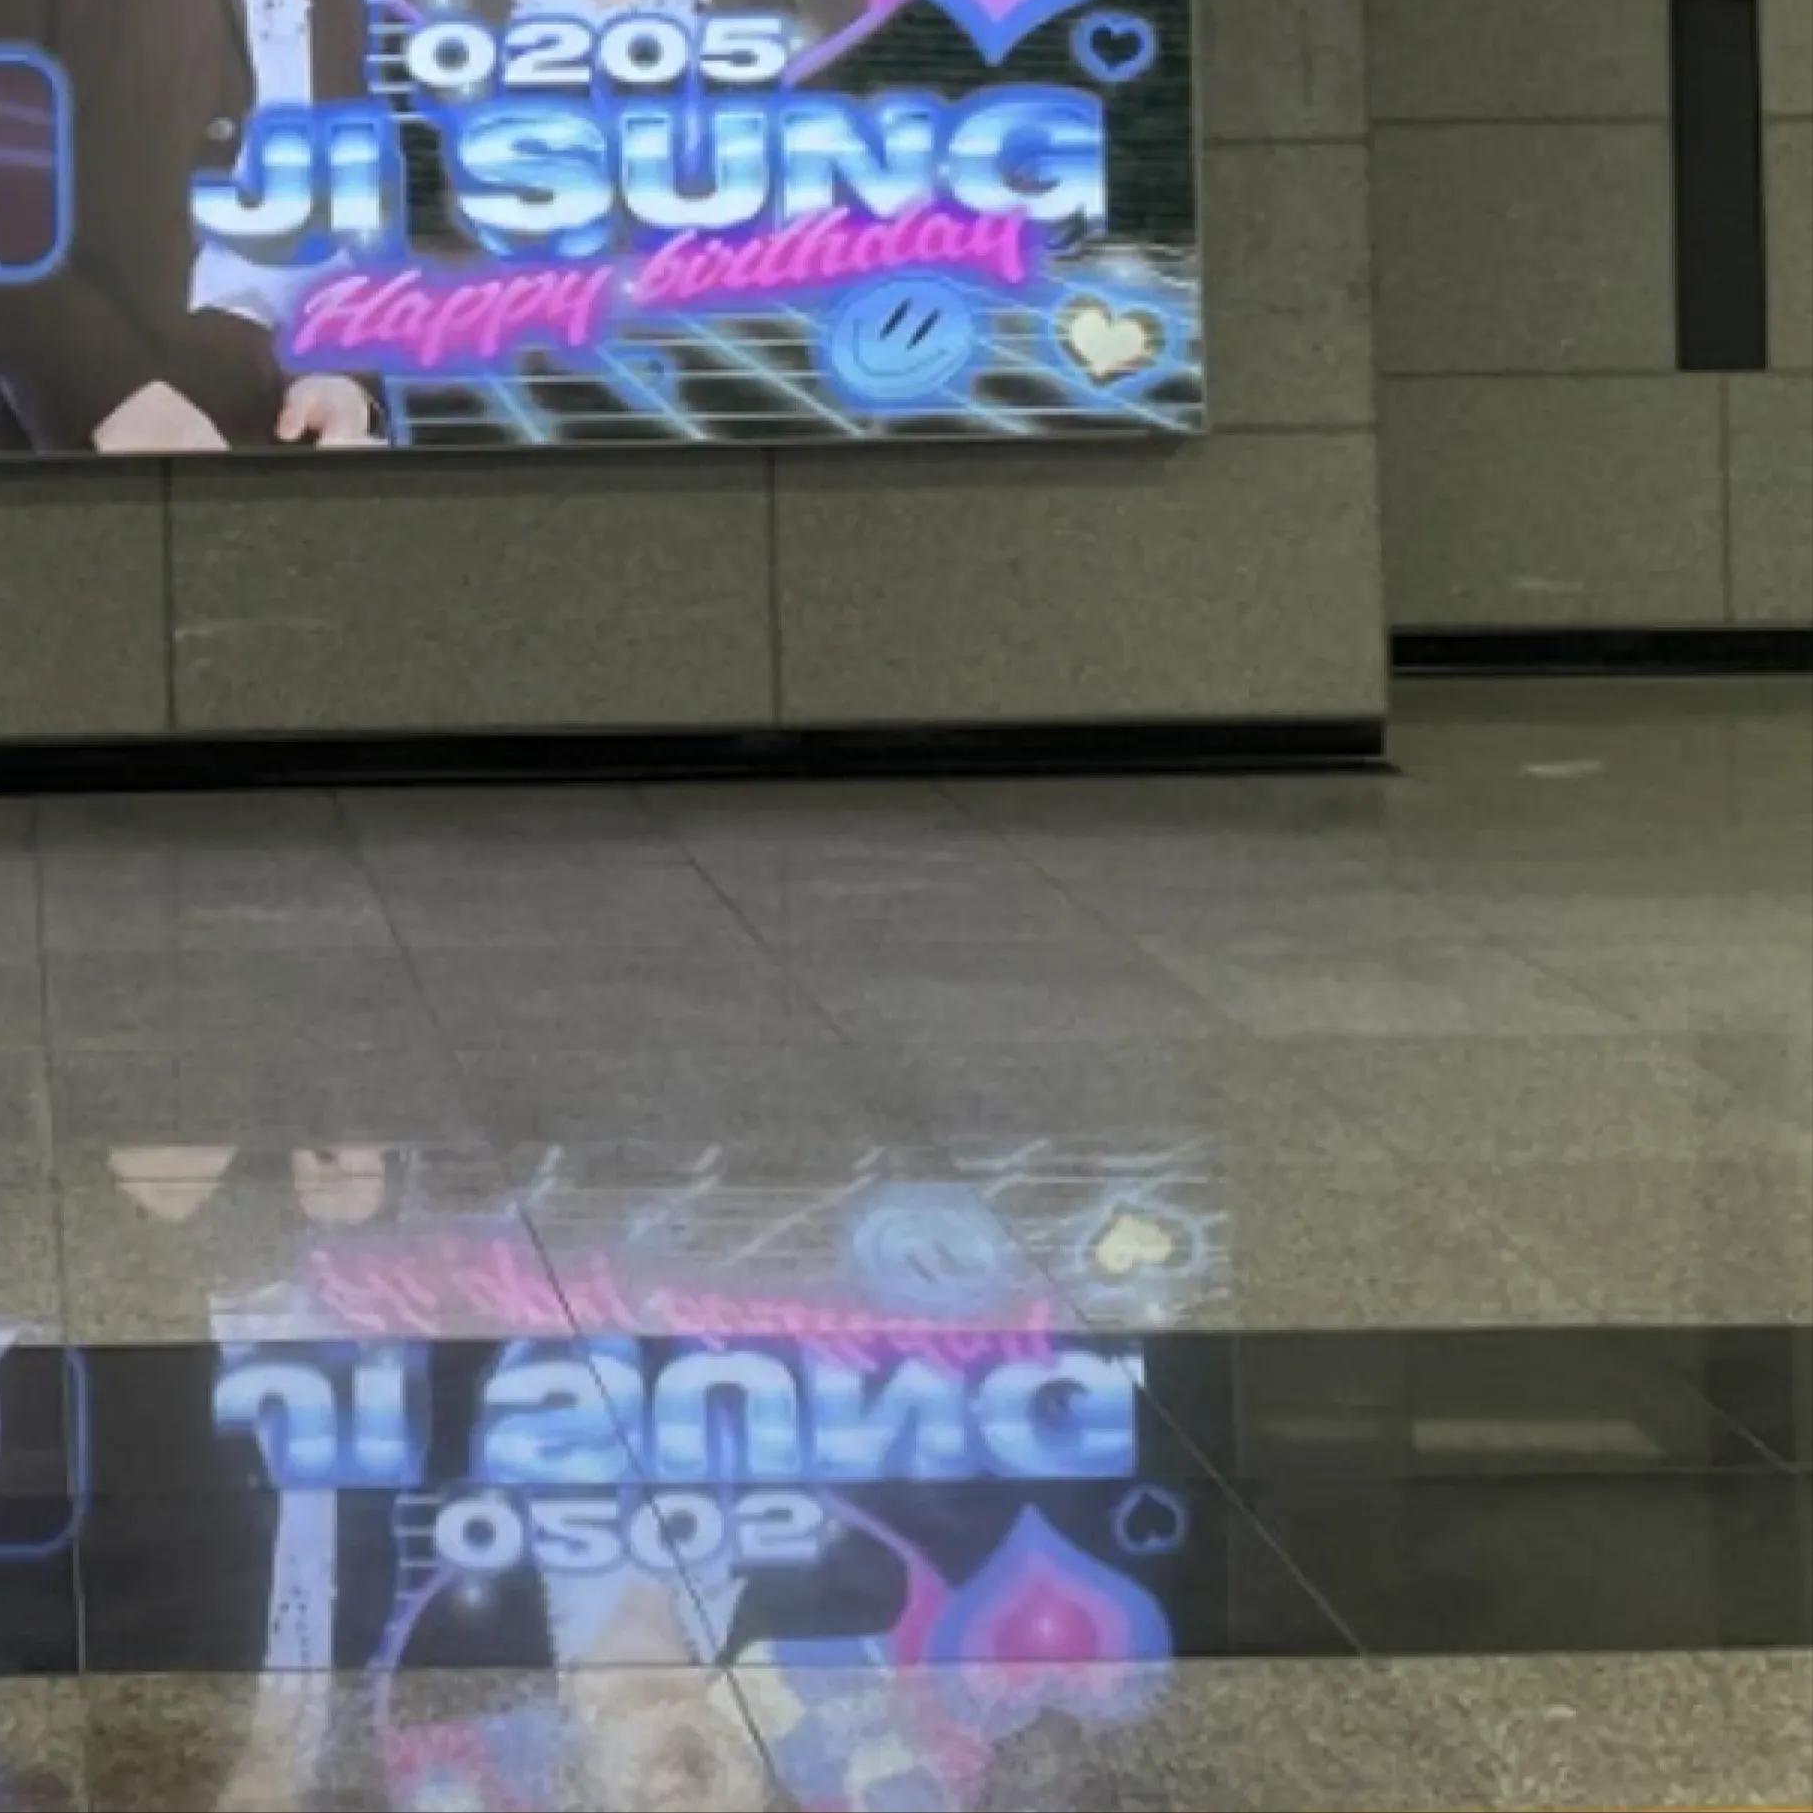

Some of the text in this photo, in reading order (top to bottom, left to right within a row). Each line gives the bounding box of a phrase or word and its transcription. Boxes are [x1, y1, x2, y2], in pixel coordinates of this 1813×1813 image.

[406, 15, 788, 84] 0205
[190, 100, 1106, 238] JI SUNG
[292, 204, 1028, 368] Happy birthday
